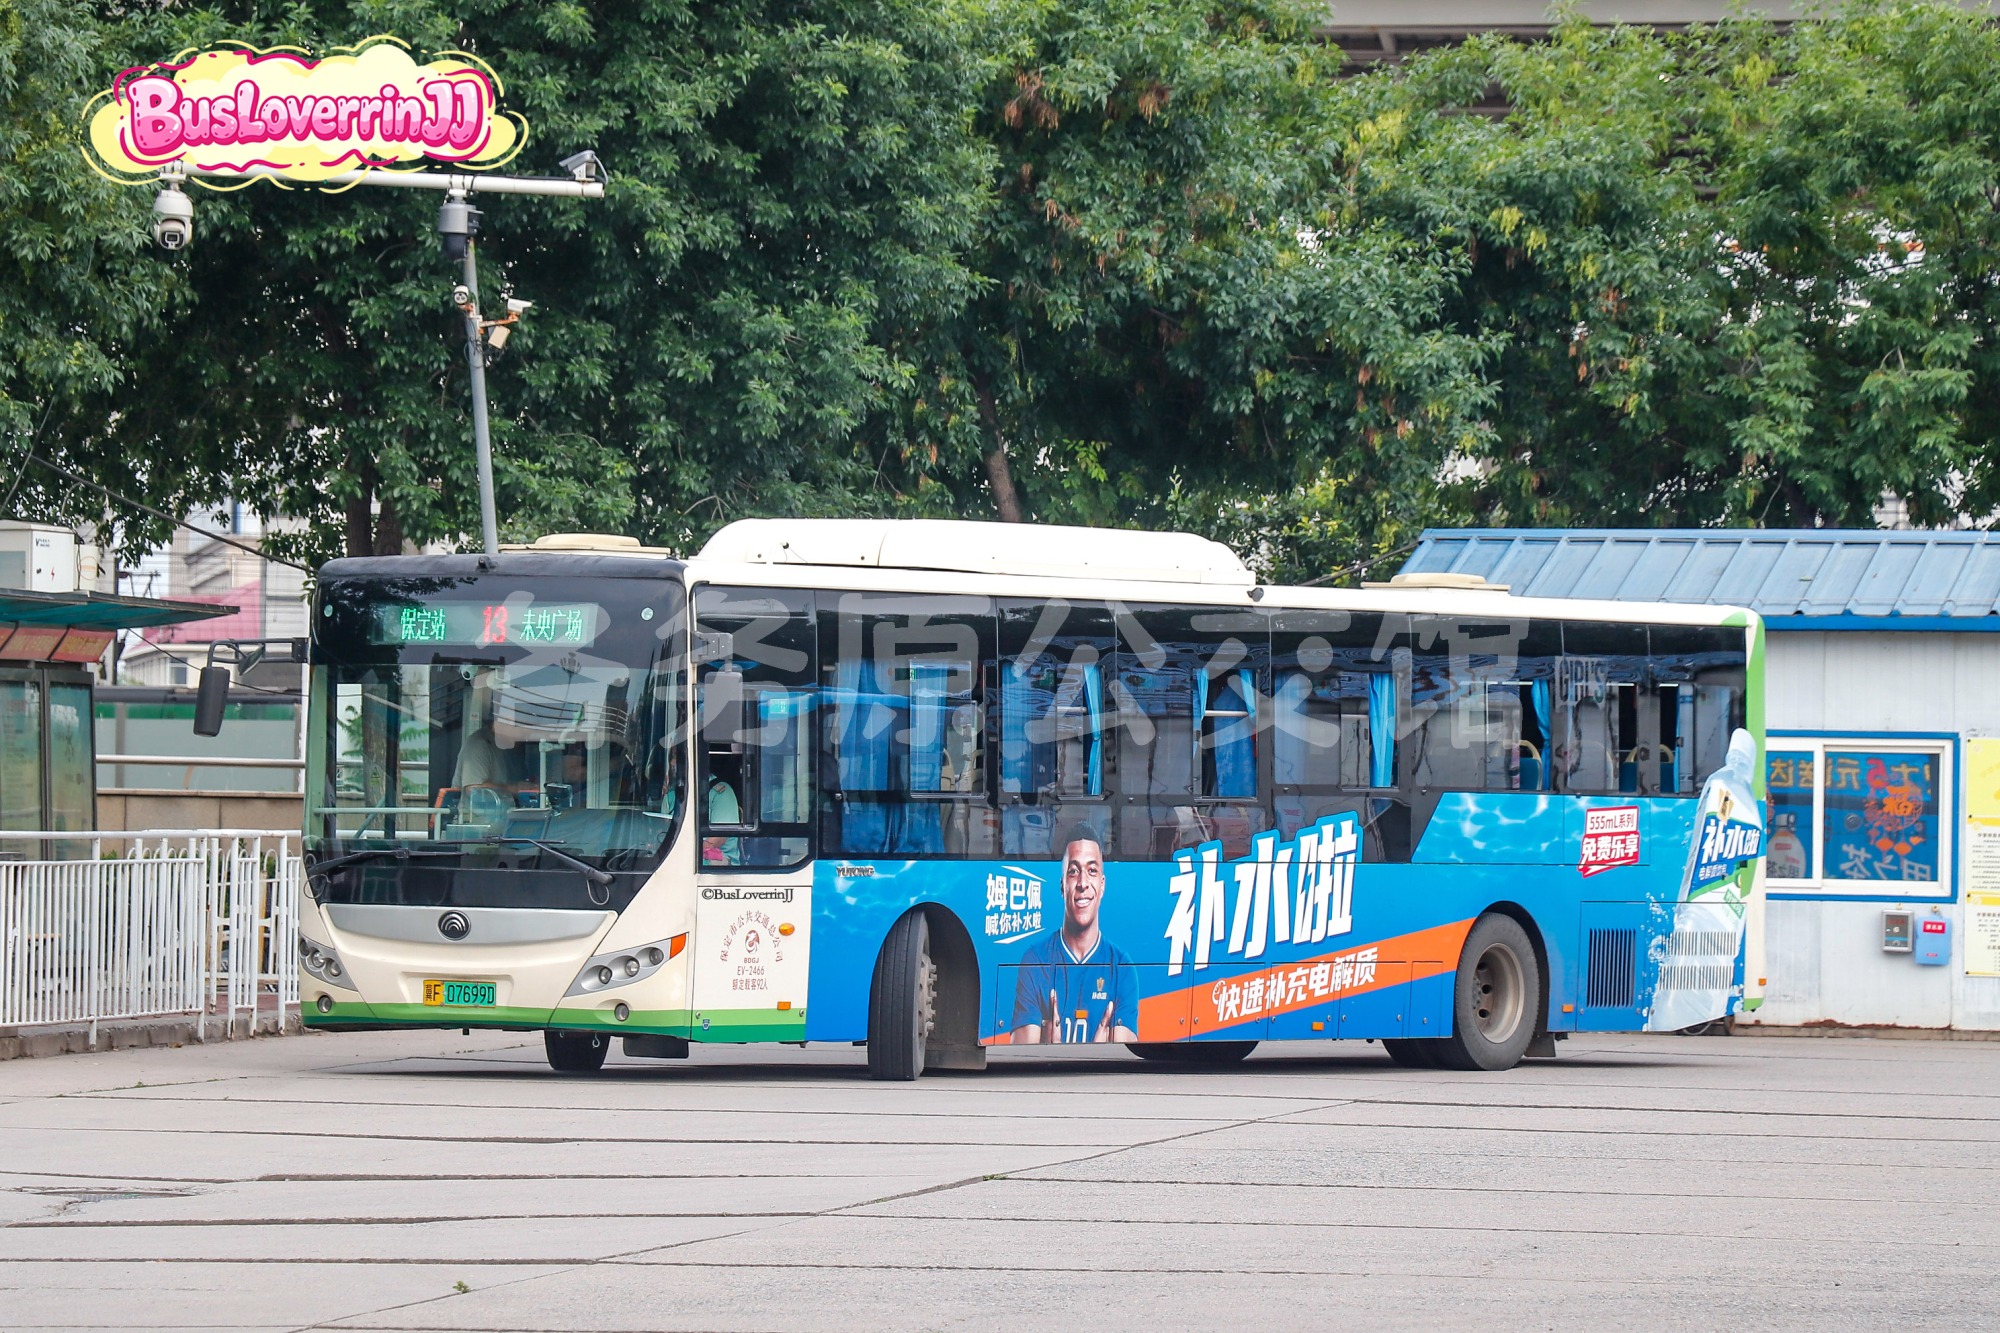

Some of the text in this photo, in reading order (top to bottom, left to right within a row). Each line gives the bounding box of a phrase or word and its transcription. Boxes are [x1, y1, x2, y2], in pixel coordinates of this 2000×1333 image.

[401, 608, 446, 641] 保定站
[483, 606, 508, 643] 13
[520, 609, 582, 641] 未央广场
[1589, 813, 1635, 830] 555mL系列
[1578, 834, 1639, 869] 免费乐享
[1701, 819, 1761, 865] 补水啦
[985, 873, 1042, 911] 姆巴佩
[1164, 820, 1357, 977] 补水啦
[720, 910, 783, 963] 保定市公共交通总公司
[985, 911, 1042, 936] 喊你补水啦
[737, 965, 765, 976] EV-2466
[1216, 947, 1378, 1022] 快速补充电解质
